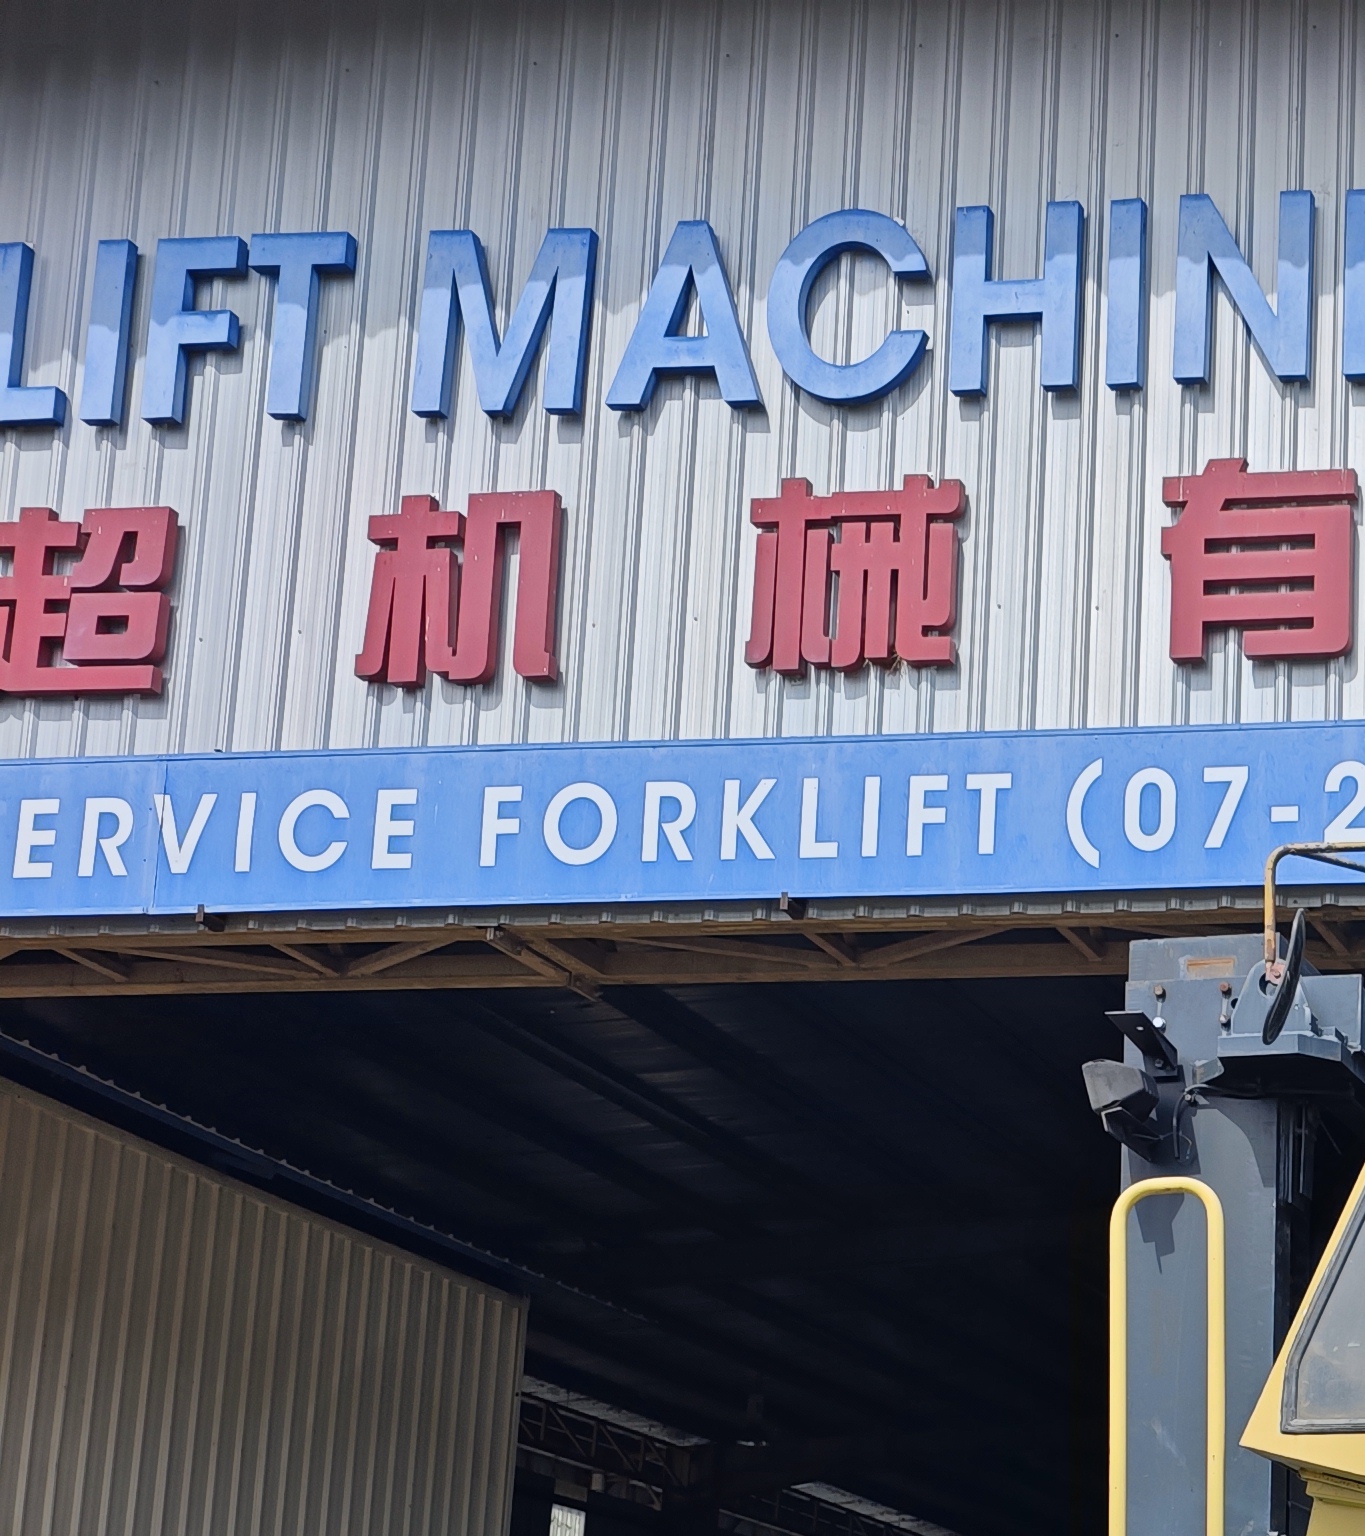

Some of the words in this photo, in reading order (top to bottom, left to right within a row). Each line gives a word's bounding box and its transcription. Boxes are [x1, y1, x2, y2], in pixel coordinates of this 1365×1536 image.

[0, 231, 357, 428] LIFT
[11, 788, 418, 879] ERVICE
[478, 771, 1013, 867] FORKLIFT
